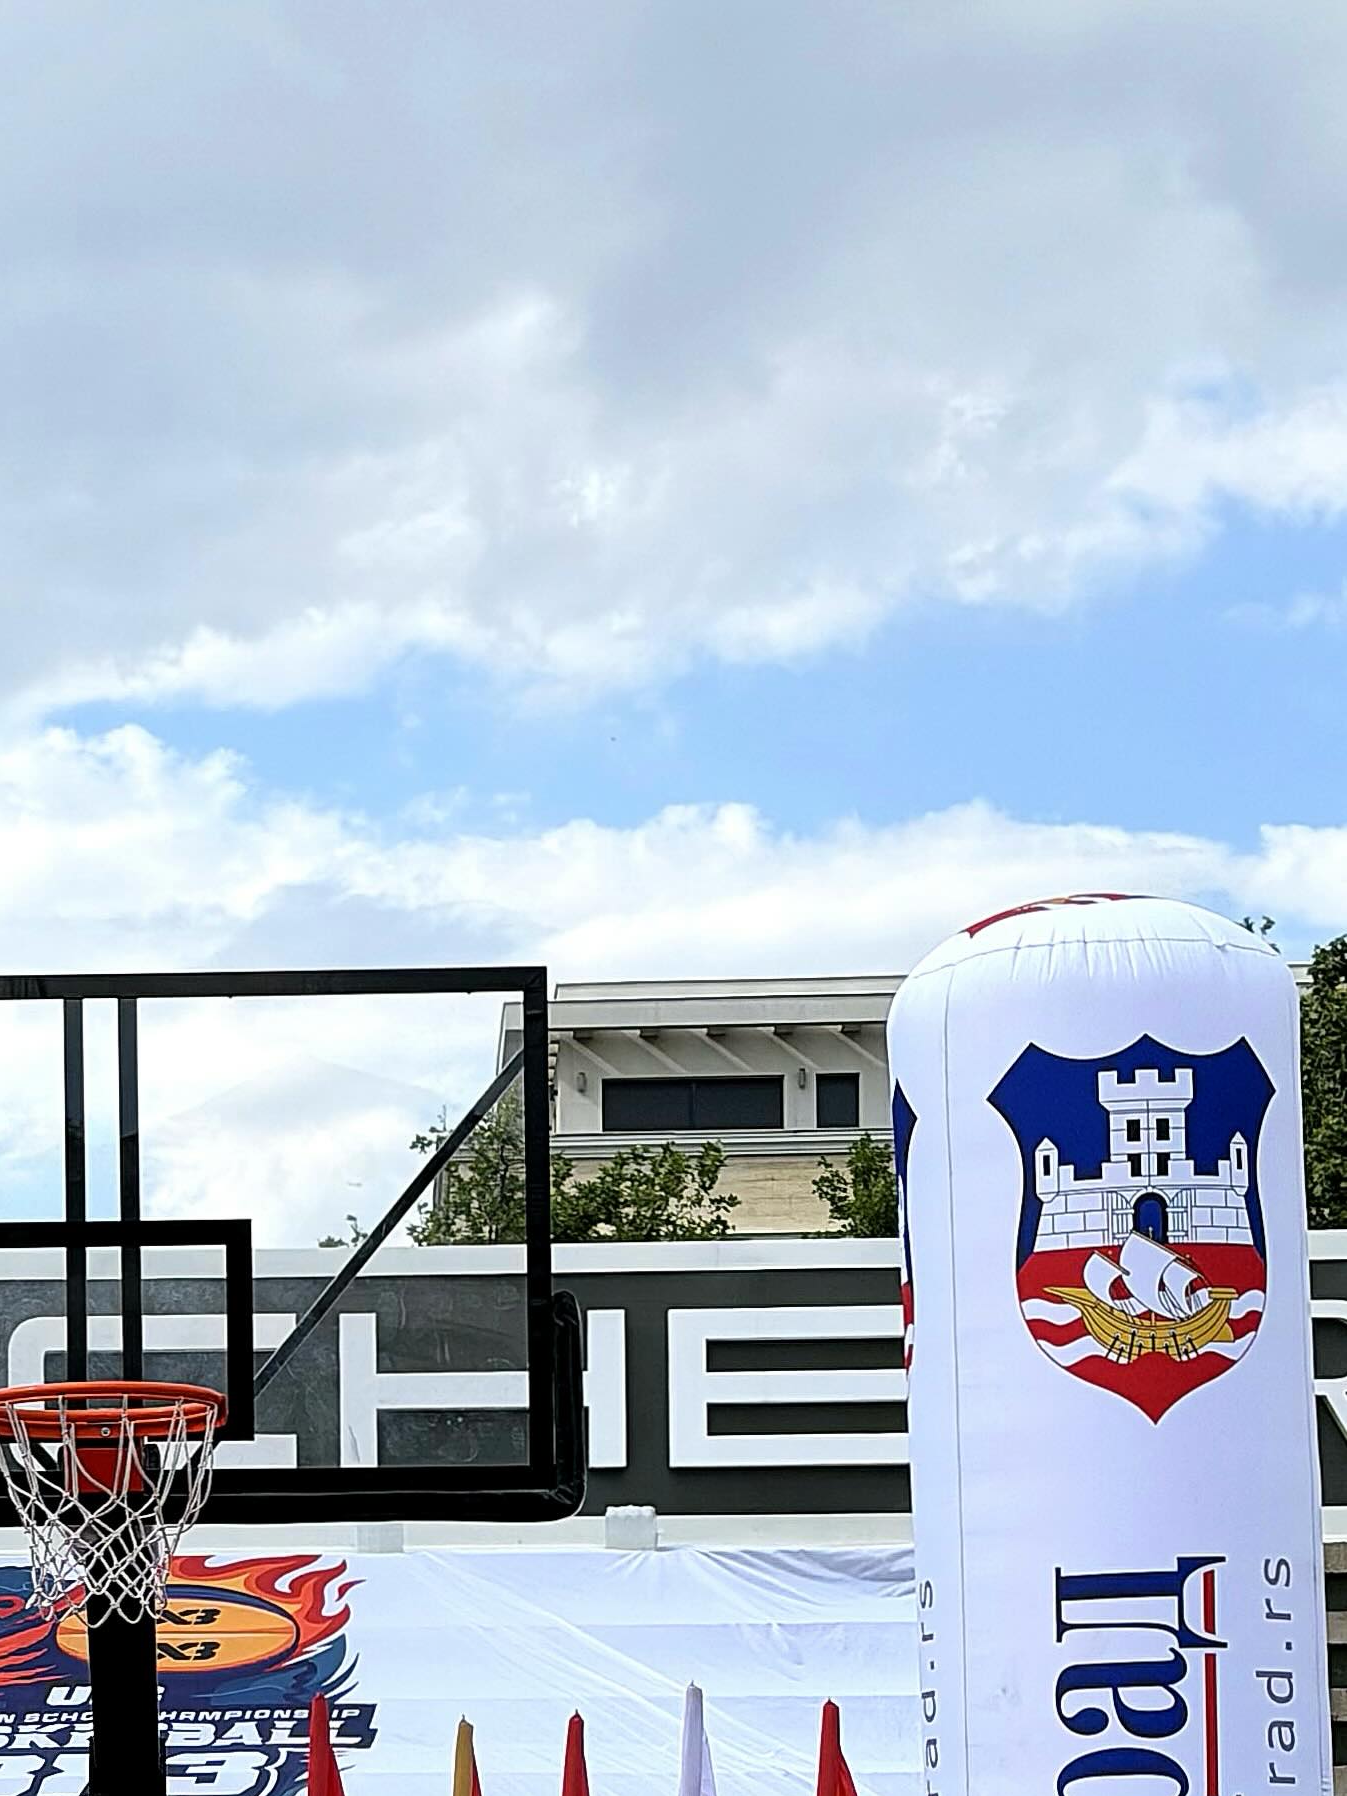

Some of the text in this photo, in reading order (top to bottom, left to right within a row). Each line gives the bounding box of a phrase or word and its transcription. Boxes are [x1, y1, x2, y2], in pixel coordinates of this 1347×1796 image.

[156, 1609, 221, 1625] X3
[156, 1642, 221, 1660] X3
[23, 1711, 93, 1724] SCHO
[155, 1709, 360, 1722] HAMPIONSIP
